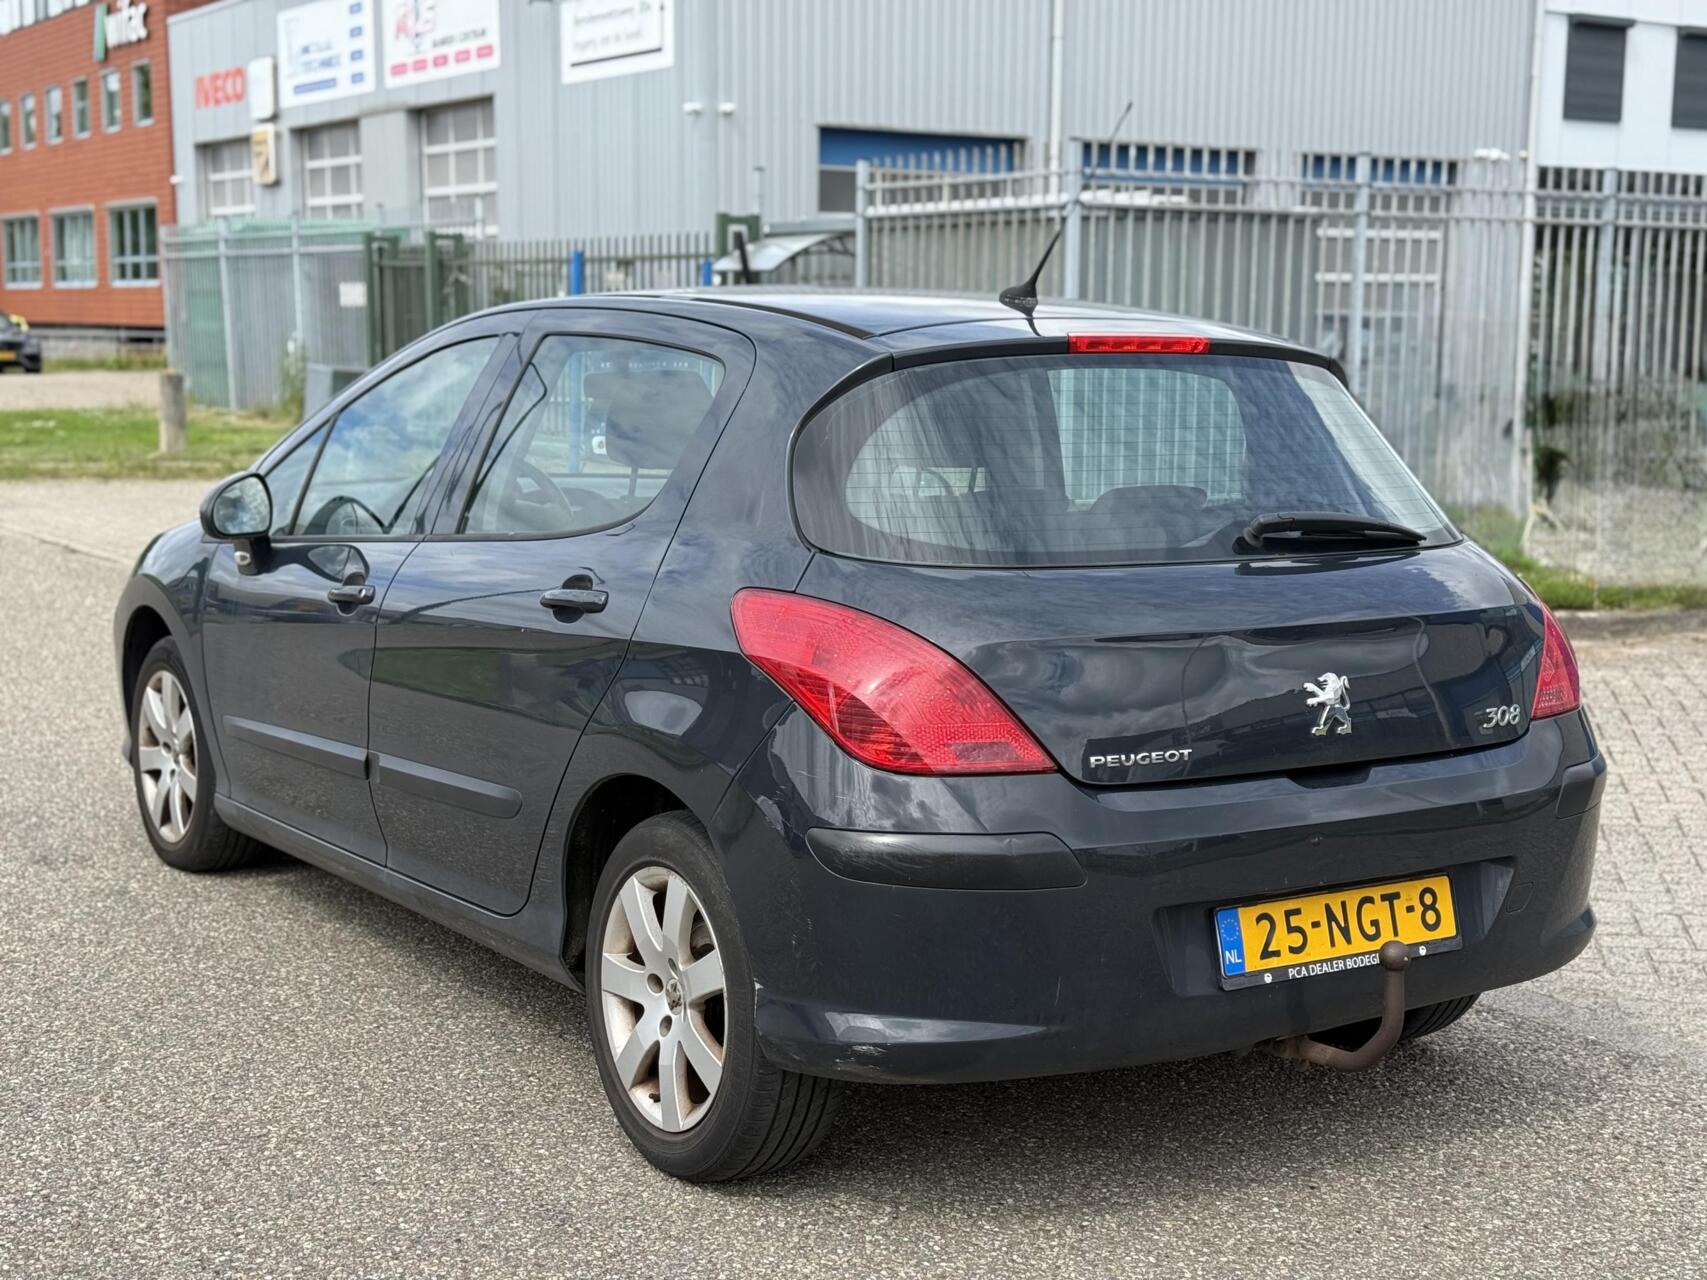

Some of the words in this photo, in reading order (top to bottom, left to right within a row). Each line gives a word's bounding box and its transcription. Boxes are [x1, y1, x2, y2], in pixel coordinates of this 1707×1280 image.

[194, 67, 246, 109] IVECO
[1483, 704, 1520, 728] 308
[1089, 749, 1192, 768] PEUGEOT
[1255, 887, 1442, 961] 25-NGT-8
[1225, 950, 1242, 965] NL
[1288, 966, 1308, 979] PCA
[1309, 960, 1345, 977] DEALER
